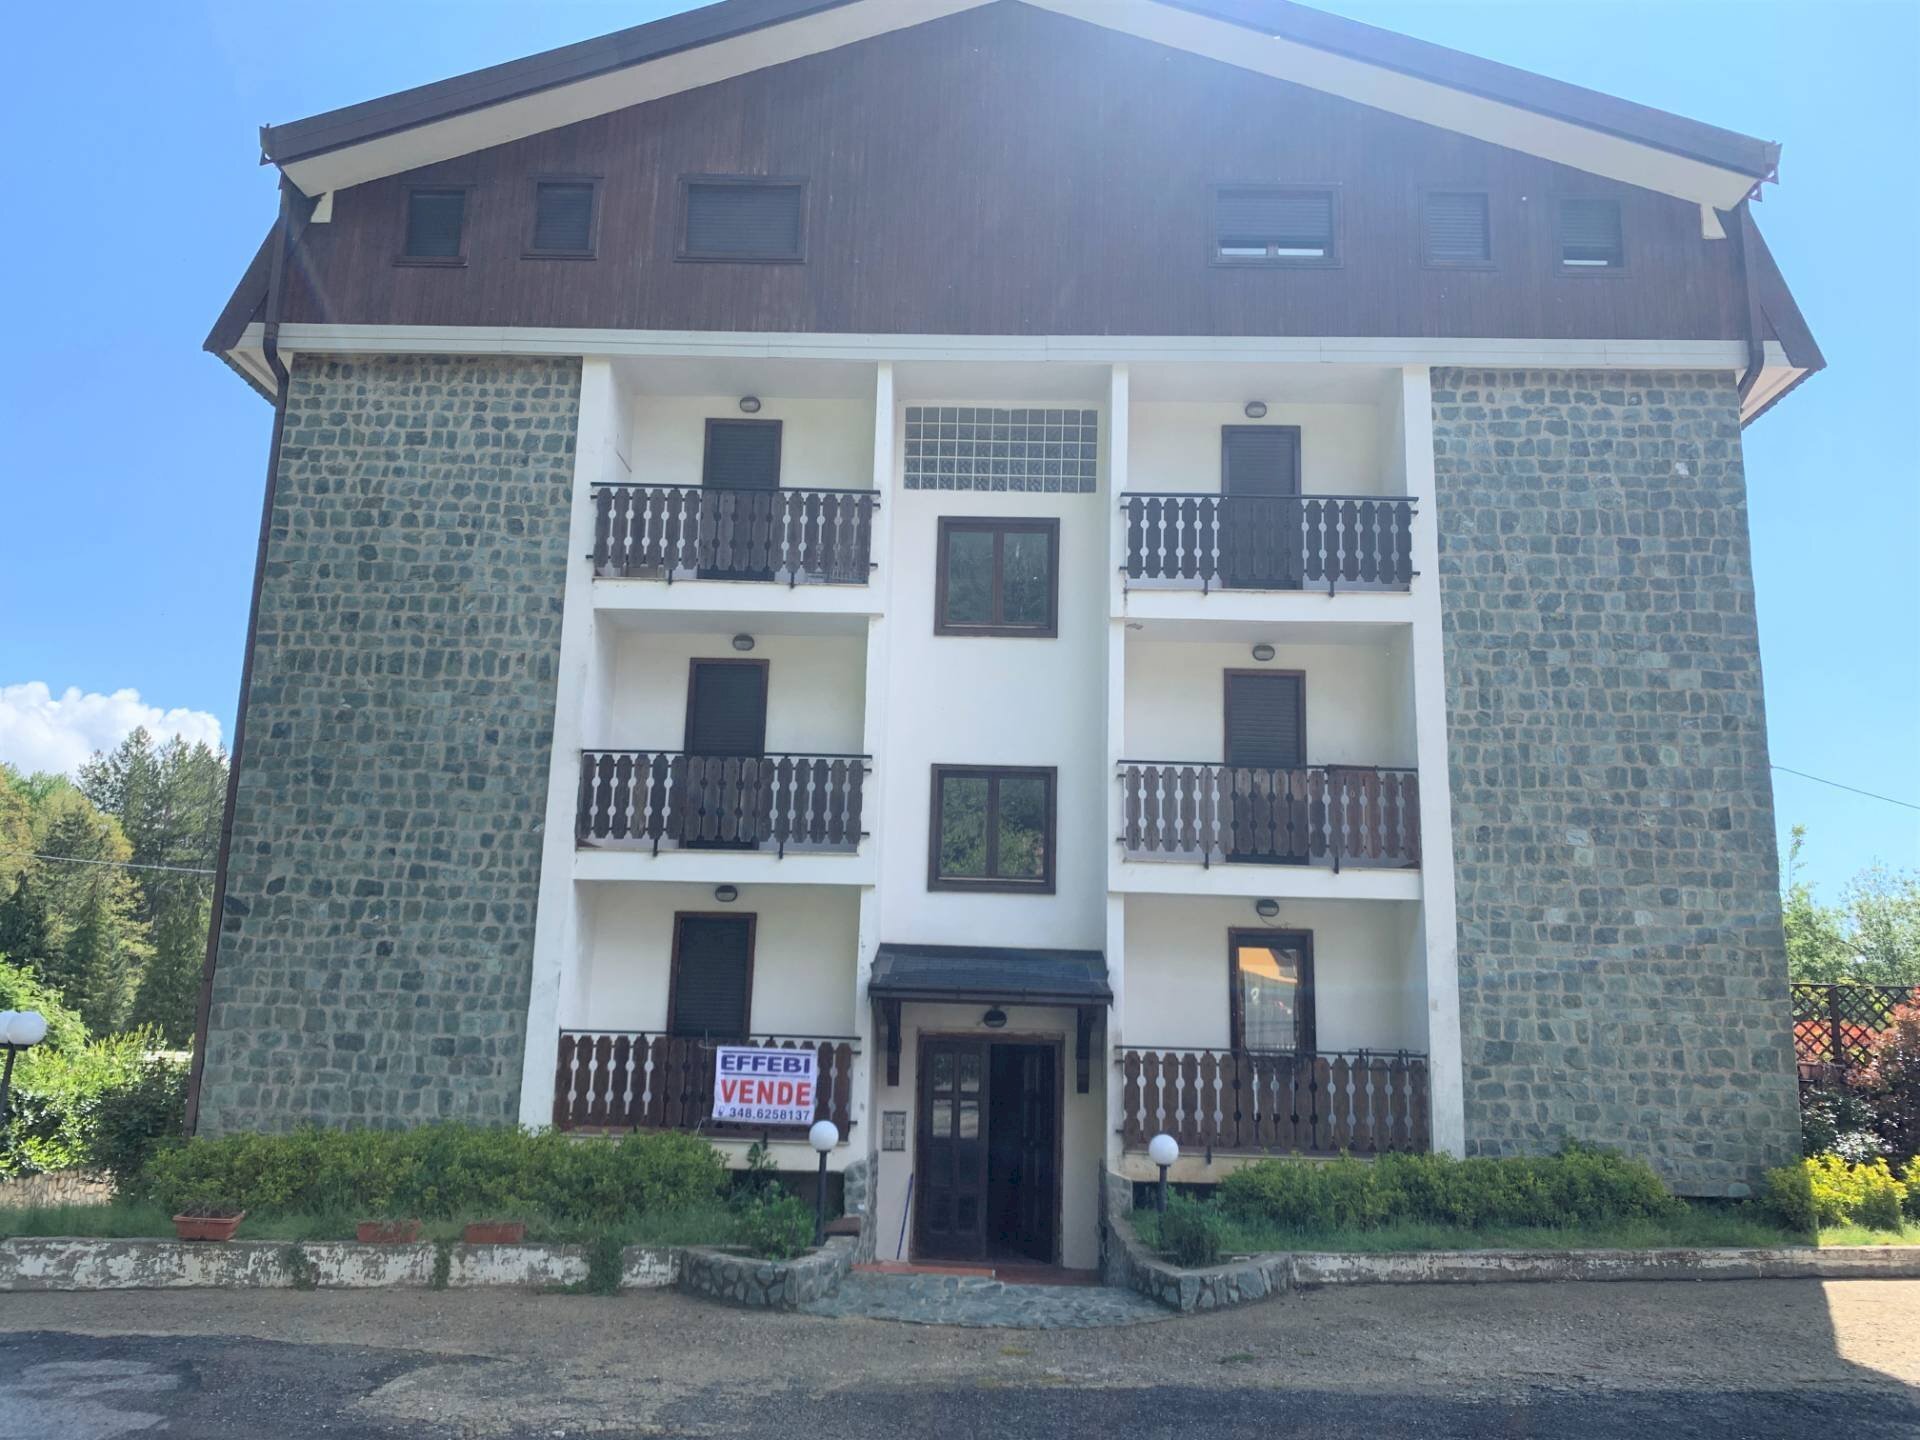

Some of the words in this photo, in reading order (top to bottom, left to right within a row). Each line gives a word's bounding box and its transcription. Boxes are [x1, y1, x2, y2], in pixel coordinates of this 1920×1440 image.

[720, 1054, 811, 1074] EFFEBI
[720, 1079, 811, 1106] VENDE
[729, 1107, 810, 1121] 348.6258137
